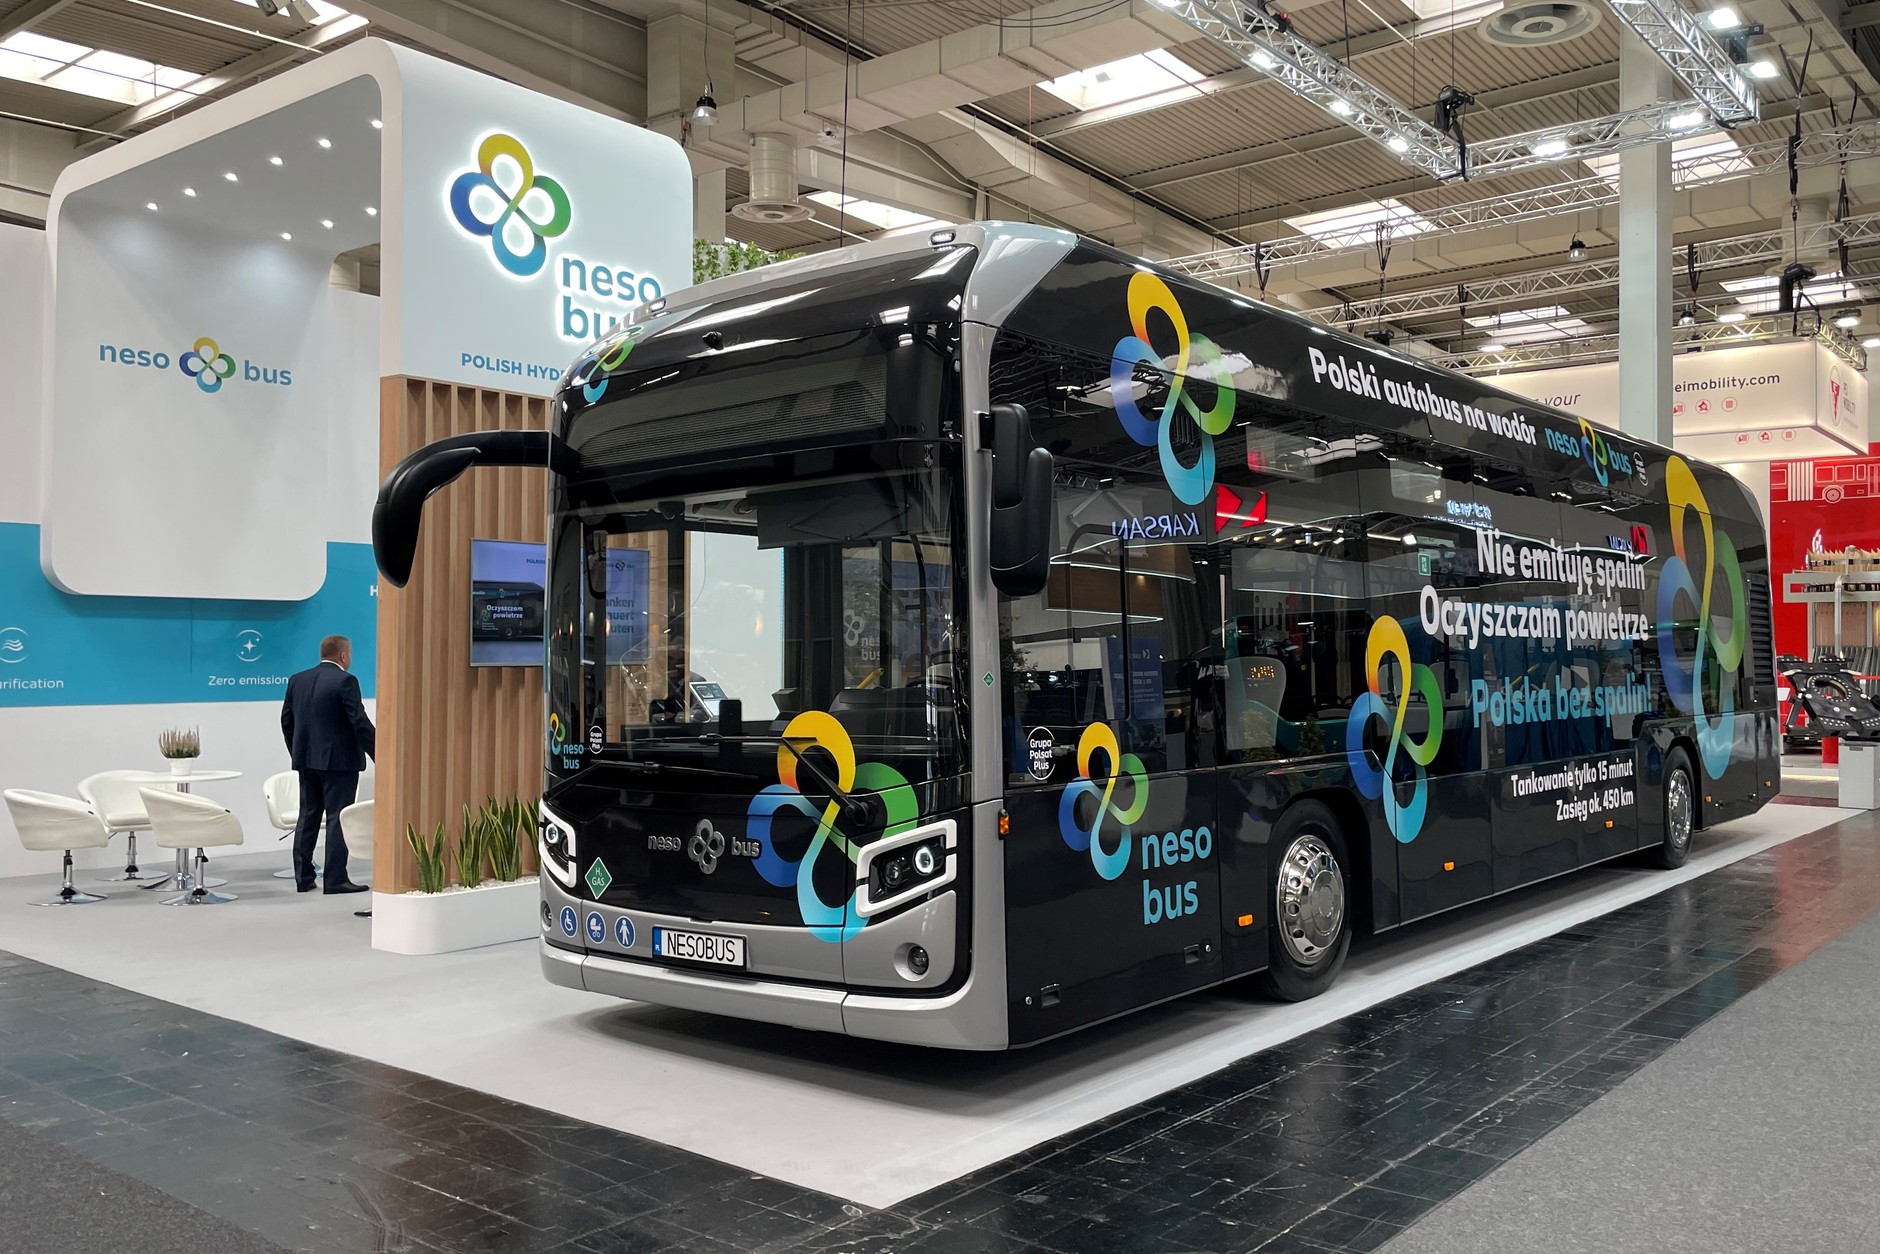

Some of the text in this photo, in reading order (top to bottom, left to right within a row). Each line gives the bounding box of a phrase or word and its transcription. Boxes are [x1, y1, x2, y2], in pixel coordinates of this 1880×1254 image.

[562, 257, 661, 304] neso
[562, 295, 616, 342] bu
[100, 344, 292, 386] neso bus
[461, 352, 522, 376] POLISH
[1308, 346, 1537, 445] Polski autobus na wodór
[1674, 374, 1780, 393] eimobility.com
[1544, 393, 1580, 407] your
[1545, 427, 1580, 459] neso
[1607, 442, 1633, 475] bus
[1476, 527, 1646, 598] Nie emituję spalin
[606, 596, 635, 608] anken
[1420, 584, 1649, 651] Oczyszczam powietrze
[861, 635, 880, 647] nes
[208, 674, 289, 686] Zero emission
[1471, 671, 1652, 728] Polska bez spalin!
[563, 744, 585, 755] neso
[1029, 749, 1053, 760] Polsat
[1030, 739, 1052, 750] Grupa
[563, 756, 580, 769] bus
[1033, 760, 1050, 771] Plus
[1511, 757, 1633, 797] Tankowanie tylko 15 minut
[1556, 786, 1634, 822] Zasięg ok. 450 km
[647, 835, 760, 857] neso bus
[1141, 826, 1212, 870] neso
[591, 876, 605, 887] GAS
[1142, 880, 1199, 925] bus
[667, 931, 736, 963] NESOBUS
